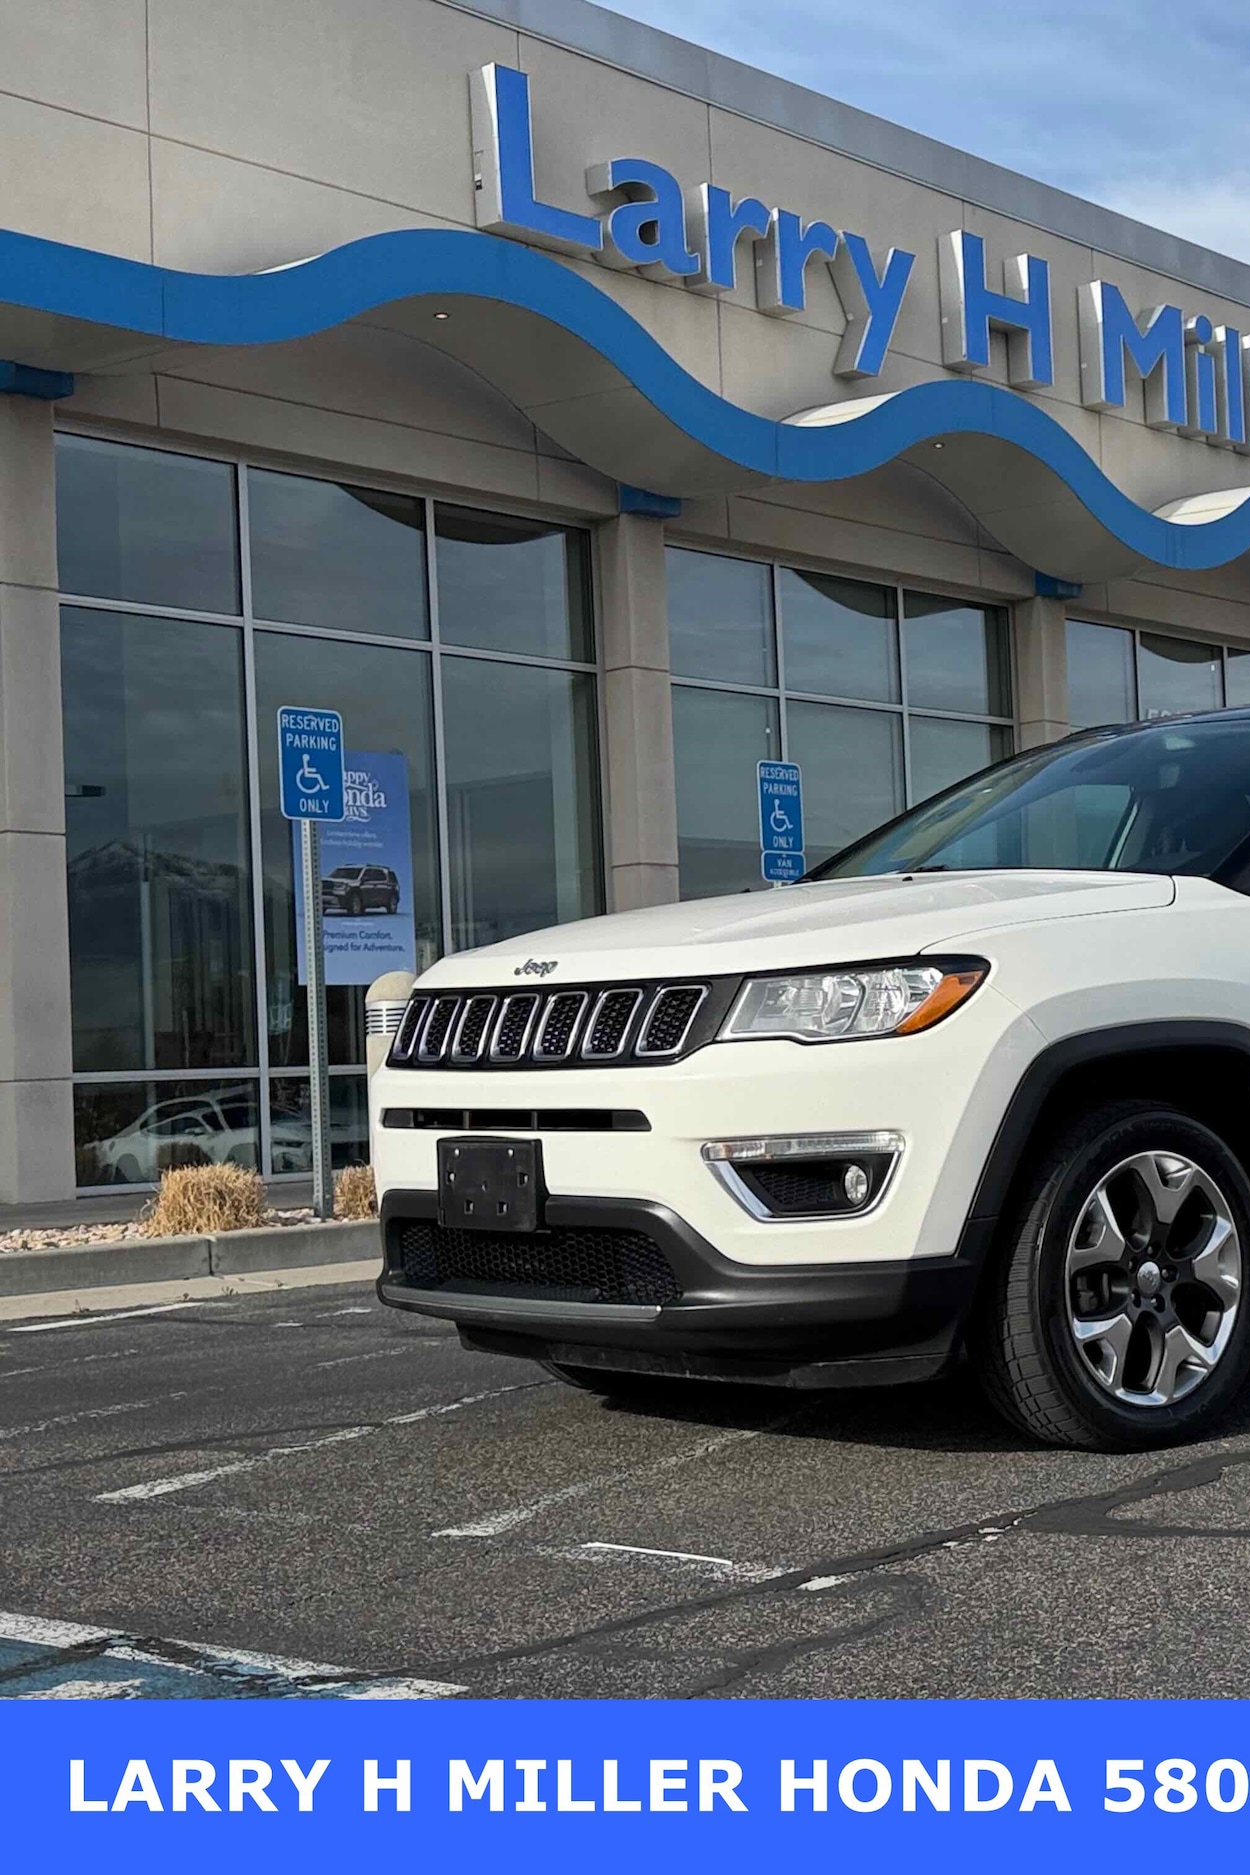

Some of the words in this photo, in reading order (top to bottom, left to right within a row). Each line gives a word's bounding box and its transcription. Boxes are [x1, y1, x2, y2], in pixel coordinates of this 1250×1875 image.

[487, 62, 916, 378] Larry
[950, 229, 1053, 389] H
[282, 714, 339, 732] RESERVED
[286, 733, 336, 751] PARKING
[760, 766, 799, 781] RESERVED
[763, 782, 798, 796] PARKING
[299, 798, 329, 813] ONLY
[772, 835, 794, 848] ONLY
[514, 958, 558, 977] Jeep
